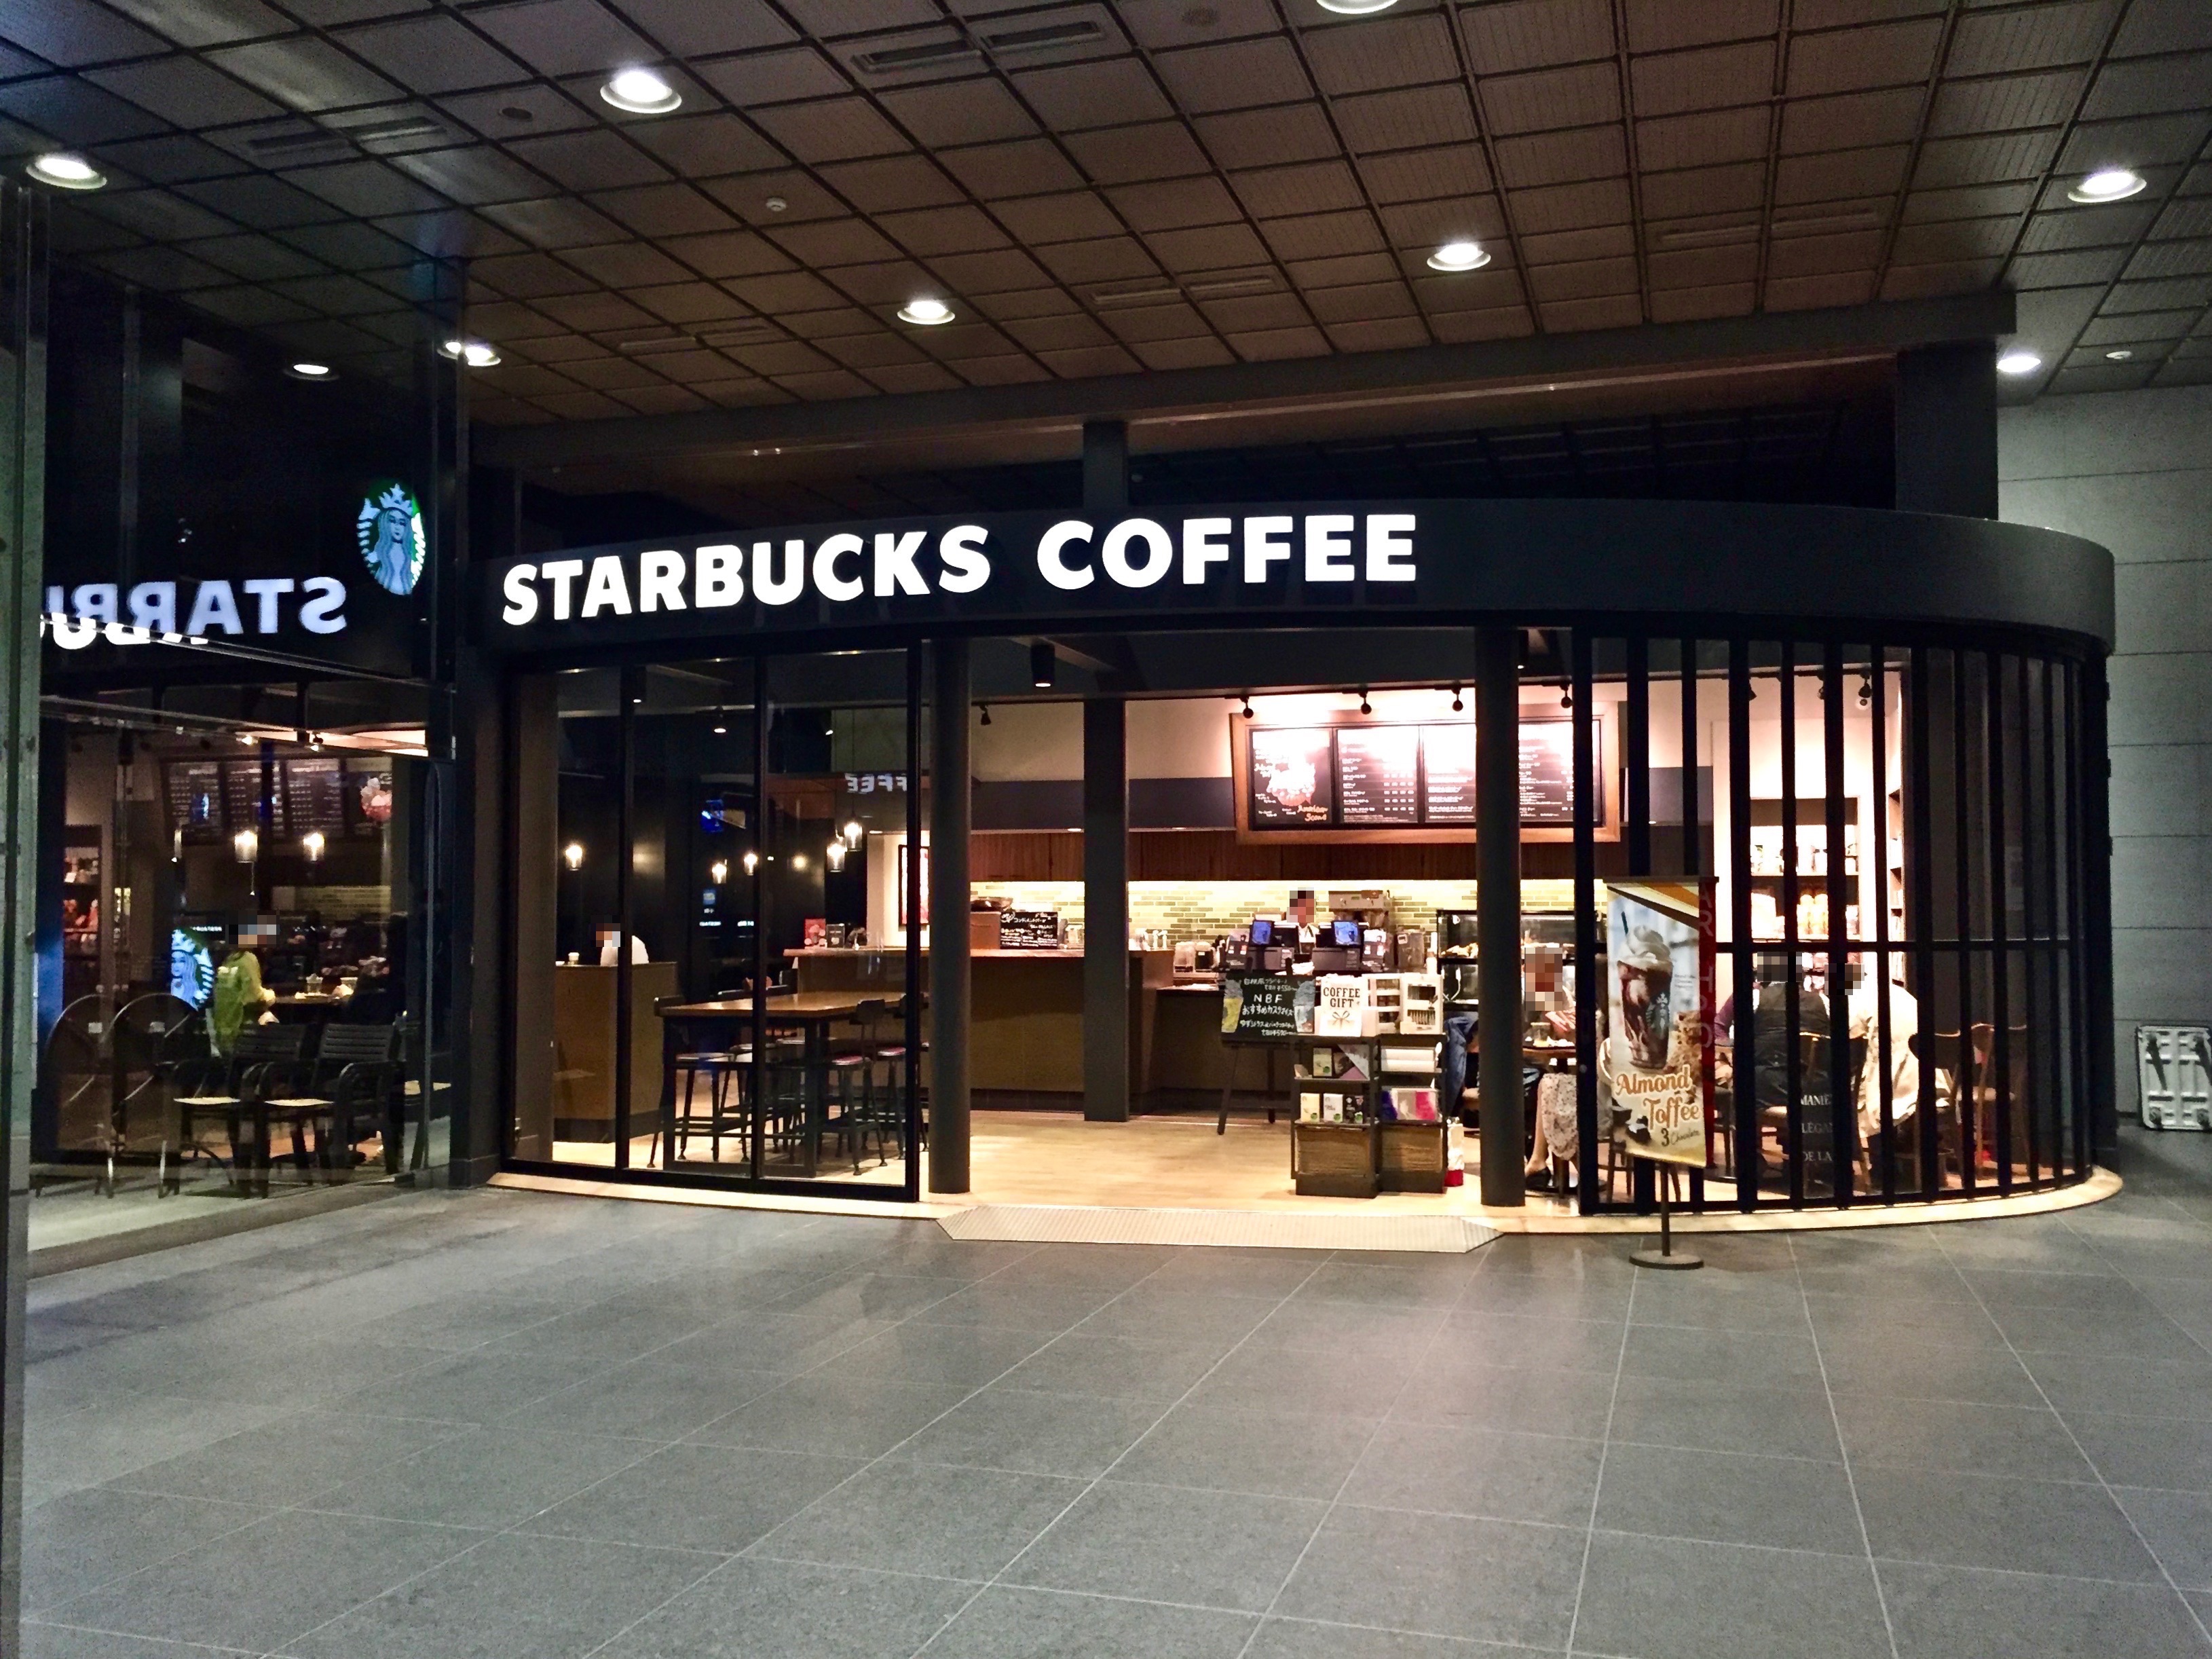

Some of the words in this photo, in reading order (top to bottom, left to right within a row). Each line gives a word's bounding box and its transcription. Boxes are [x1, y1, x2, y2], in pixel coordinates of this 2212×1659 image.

[502, 525, 991, 626] STARBUCKS
[1037, 515, 1417, 590] COFFEE
[1324, 987, 1360, 998] COFFEE
[1330, 998, 1354, 1008] GIFT
[1615, 1066, 1691, 1096] Almond
[1643, 1096, 1700, 1130] Toffee
[1661, 1127, 1670, 1147] 3
